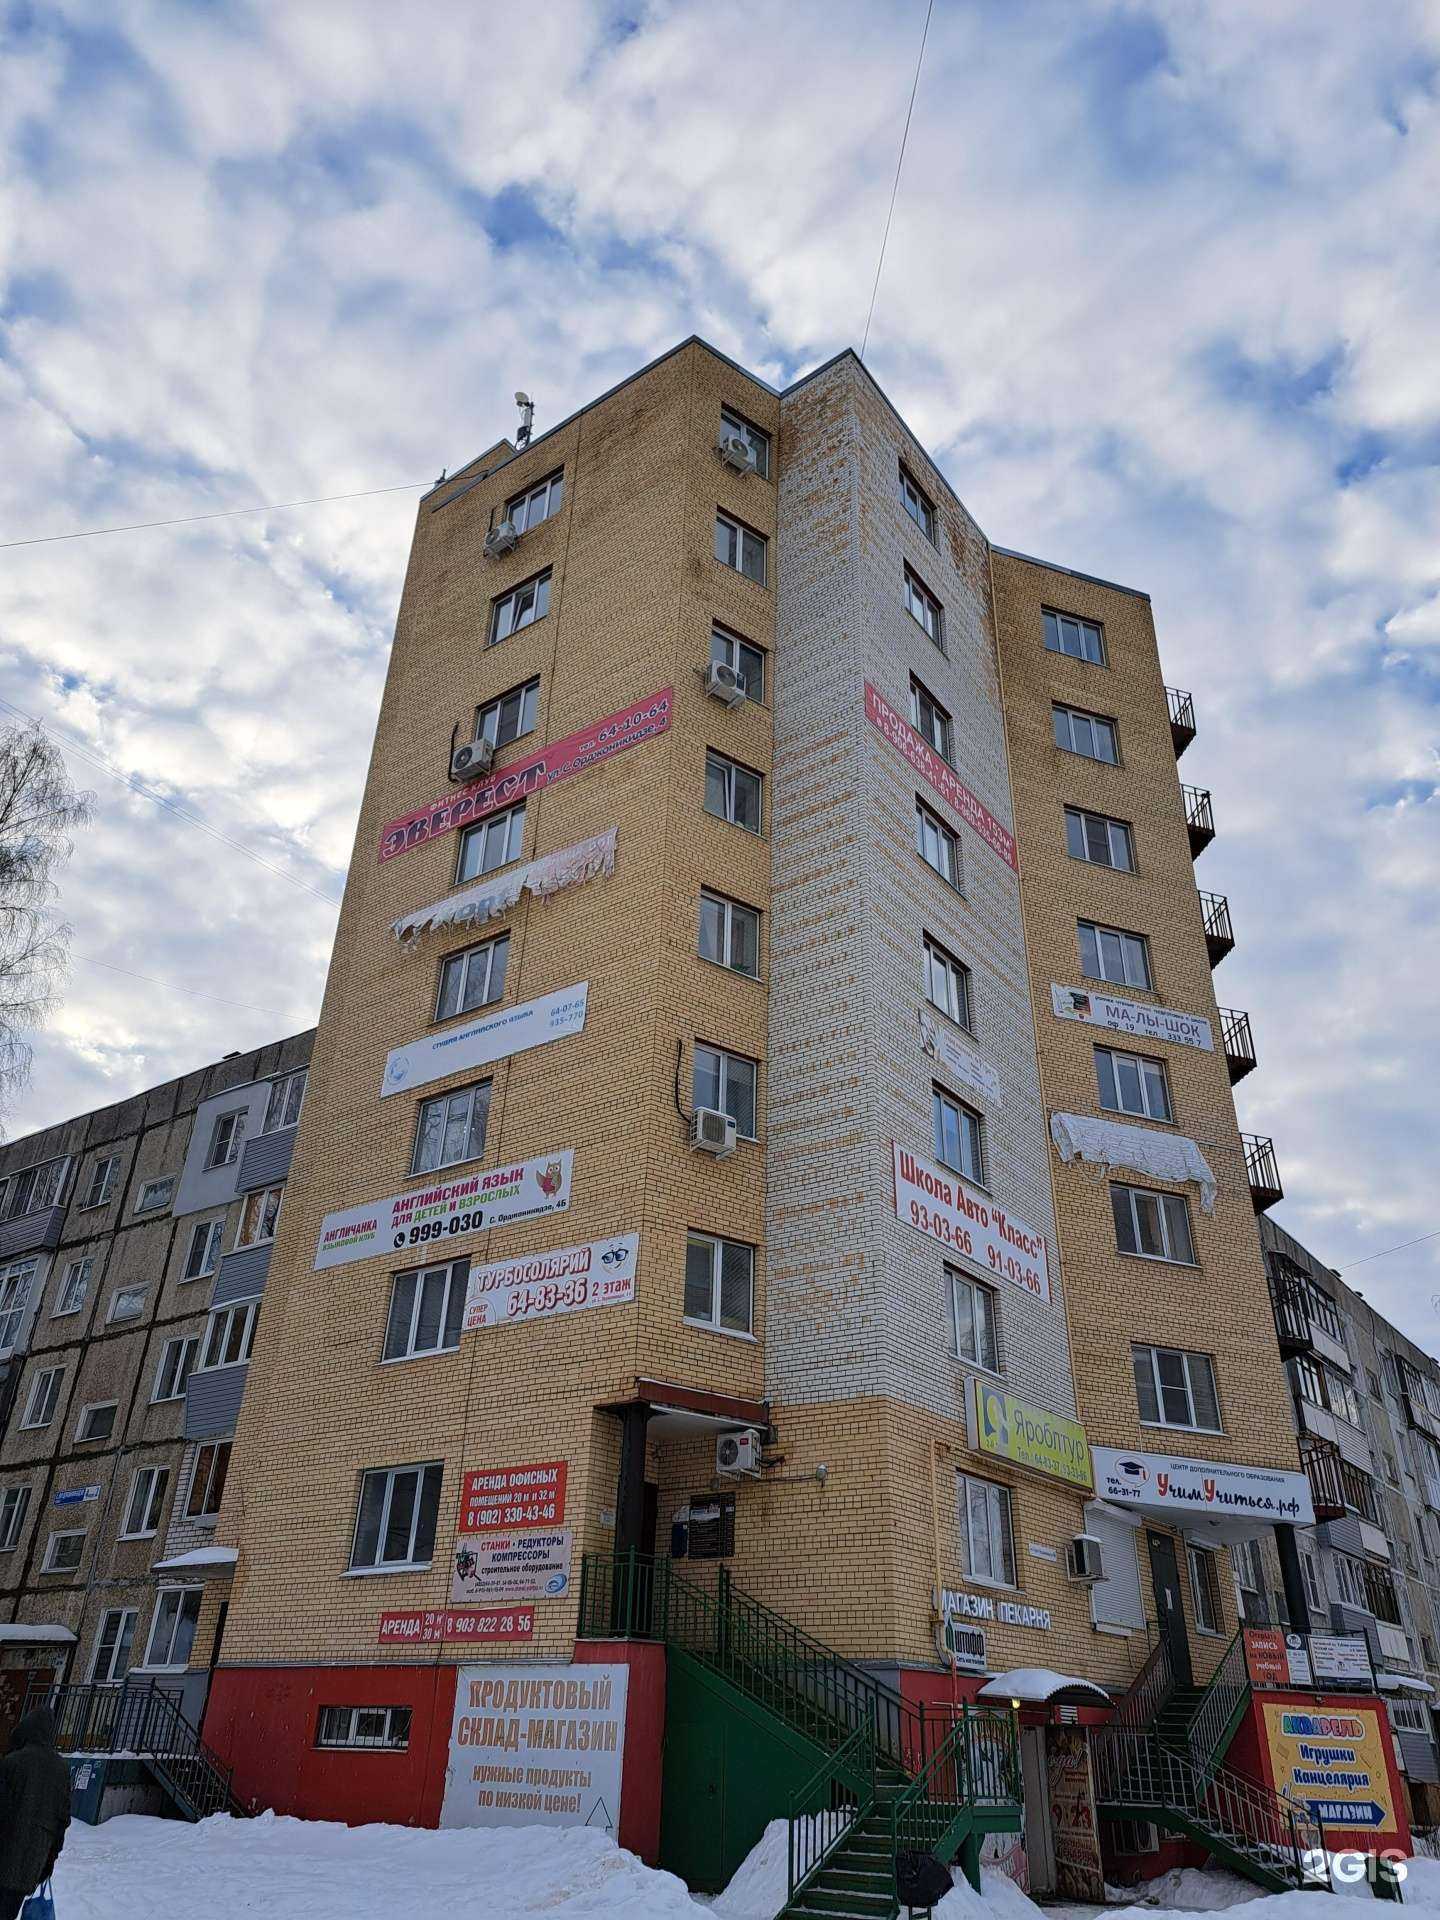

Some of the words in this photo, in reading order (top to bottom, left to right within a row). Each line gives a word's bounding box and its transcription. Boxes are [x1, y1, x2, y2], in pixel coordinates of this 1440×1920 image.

[598, 698, 669, 742] 64-10-64
[872, 694, 933, 767] ПРОДАЖА
[941, 770, 985, 822] АРЕНДА
[383, 760, 546, 858] ЭВЕРЕСТ
[1105, 1005, 1201, 1038] МА-ЛЫ-ШОК
[1125, 1022, 1135, 1031] 19
[1167, 1032, 1182, 1042] 333
[392, 1176, 479, 1214] АНГЛИЙСКИЙ
[482, 1167, 524, 1190] ЯЗЫК
[899, 1149, 953, 1208] Школа
[956, 1184, 988, 1228] Авто
[391, 1212, 412, 1229] ДЛЯ
[414, 1203, 448, 1223] ДЕТЕЙ
[458, 1184, 520, 1210] ВЗРОСЛЫХ
[556, 1199, 567, 1208] 4Б
[323, 1219, 378, 1243] АНГЛИЧАНКА
[409, 1210, 484, 1245] 999-030
[910, 1199, 973, 1256] 93-03-66
[987, 1244, 1042, 1296] 91-03-66
[478, 1247, 592, 1292] ТУРБОСОЛЯРИЙ
[507, 1278, 588, 1316] 64-83-36
[591, 1282, 599, 1297] 2
[603, 1277, 632, 1295] этаж
[467, 1314, 487, 1328] ЦЕНА
[469, 1304, 488, 1314] СУПЕР
[471, 1474, 507, 1491] АРЕНДА
[509, 1468, 558, 1487] ОФИСНЫХ
[1106, 1477, 1121, 1486] тел.
[1170, 1463, 1189, 1471] ЦЕНТР
[1189, 1465, 1245, 1479] ДОПОЛНИТЕЛЬНОГО
[1245, 1472, 1285, 1483] ОБРАЗОВАНИЯ
[469, 1491, 512, 1507] ПОМЕЩЕНИЙ
[513, 1492, 522, 1504] 20
[538, 1490, 548, 1500] 32
[1107, 1486, 1141, 1498] 66-31-77
[467, 1511, 474, 1526] 8
[476, 1509, 501, 1527] (902)
[504, 1503, 555, 1523] 330-43-46
[480, 1540, 511, 1552] СТАНКИ
[517, 1536, 564, 1549] РЕДУКТОРЫ
[491, 1549, 550, 1562] КОМПРЕССОРЫ
[481, 1565, 520, 1575] строительное
[521, 1562, 563, 1574] оборудование
[381, 1619, 421, 1637] АРЕНДА
[425, 1613, 435, 1625] 20
[447, 1617, 453, 1633] 8
[456, 1617, 474, 1633] 903
[477, 1616, 496, 1633] 822
[500, 1616, 514, 1632] 28
[517, 1615, 531, 1631] 56
[999, 1601, 1051, 1631] ПЕКАРНЯ
[1251, 1641, 1278, 1650] ЗАПИСЬ
[469, 1674, 613, 1713] ПРОДУКТОВЫЙ
[457, 1717, 618, 1752] СКЛАД-МАГАЗИН
[1283, 1714, 1364, 1738] АКВАРЕЛЬ
[1300, 1744, 1356, 1766] Игрушки
[472, 1765, 524, 1784] нужные
[525, 1769, 592, 1788] продукты
[1293, 1768, 1370, 1791] Канцелярия
[478, 1789, 493, 1807] по
[496, 1790, 543, 1811] низкой
[544, 1793, 582, 1814] цене!
[1318, 1804, 1373, 1820] МАГАЗИН
